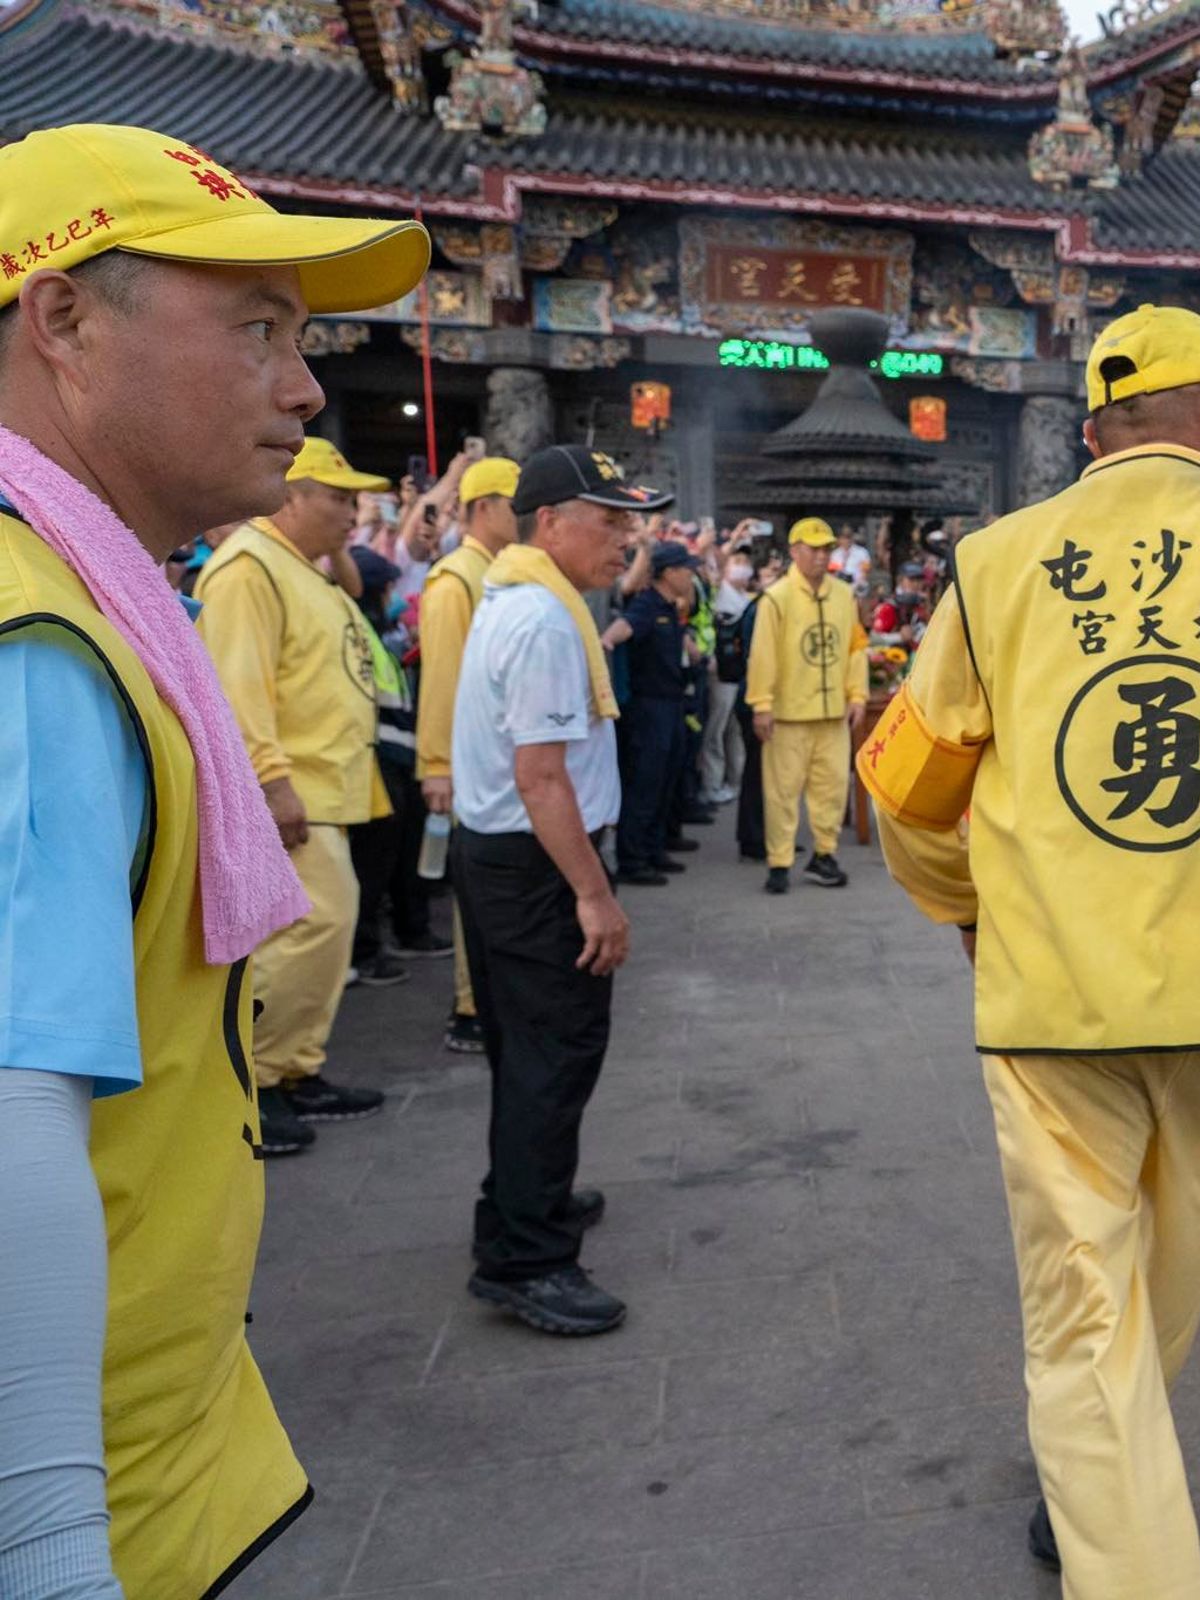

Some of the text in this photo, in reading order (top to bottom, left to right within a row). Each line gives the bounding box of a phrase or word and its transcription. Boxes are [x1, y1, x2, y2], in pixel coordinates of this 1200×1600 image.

[0, 208, 115, 280] 歲次乙巳年
